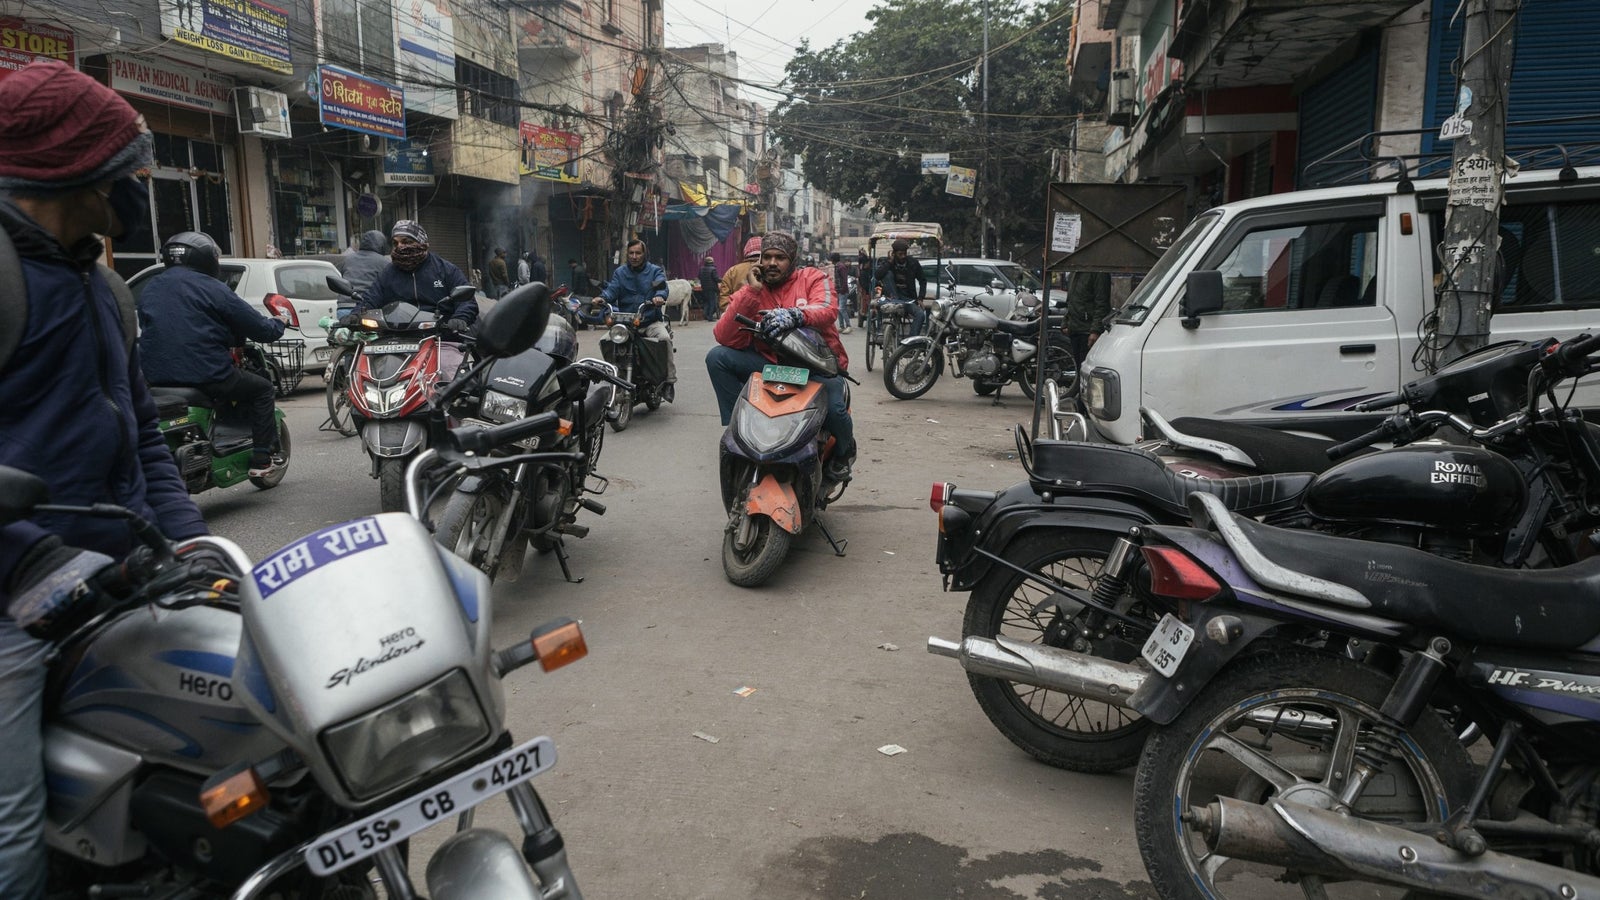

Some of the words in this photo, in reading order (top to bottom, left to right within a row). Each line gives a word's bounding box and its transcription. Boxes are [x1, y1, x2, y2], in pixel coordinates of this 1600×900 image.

[2, 27, 69, 61] STORE
[176, 28, 204, 46] WEIGHT
[206, 39, 224, 52] LOSS
[228, 46, 245, 58] GAIN
[115, 59, 150, 82] PAWAN
[152, 69, 190, 93] MEDICAL
[333, 80, 363, 106] शिवम
[1434, 460, 1483, 475] ROYAL
[254, 541, 317, 590] राम
[317, 518, 384, 557] राम
[379, 626, 416, 647] Hero
[179, 672, 234, 702] Hero
[318, 838, 355, 869] DL
[357, 819, 392, 850] 5S
[419, 790, 456, 821] CB
[491, 745, 544, 786] 4227
